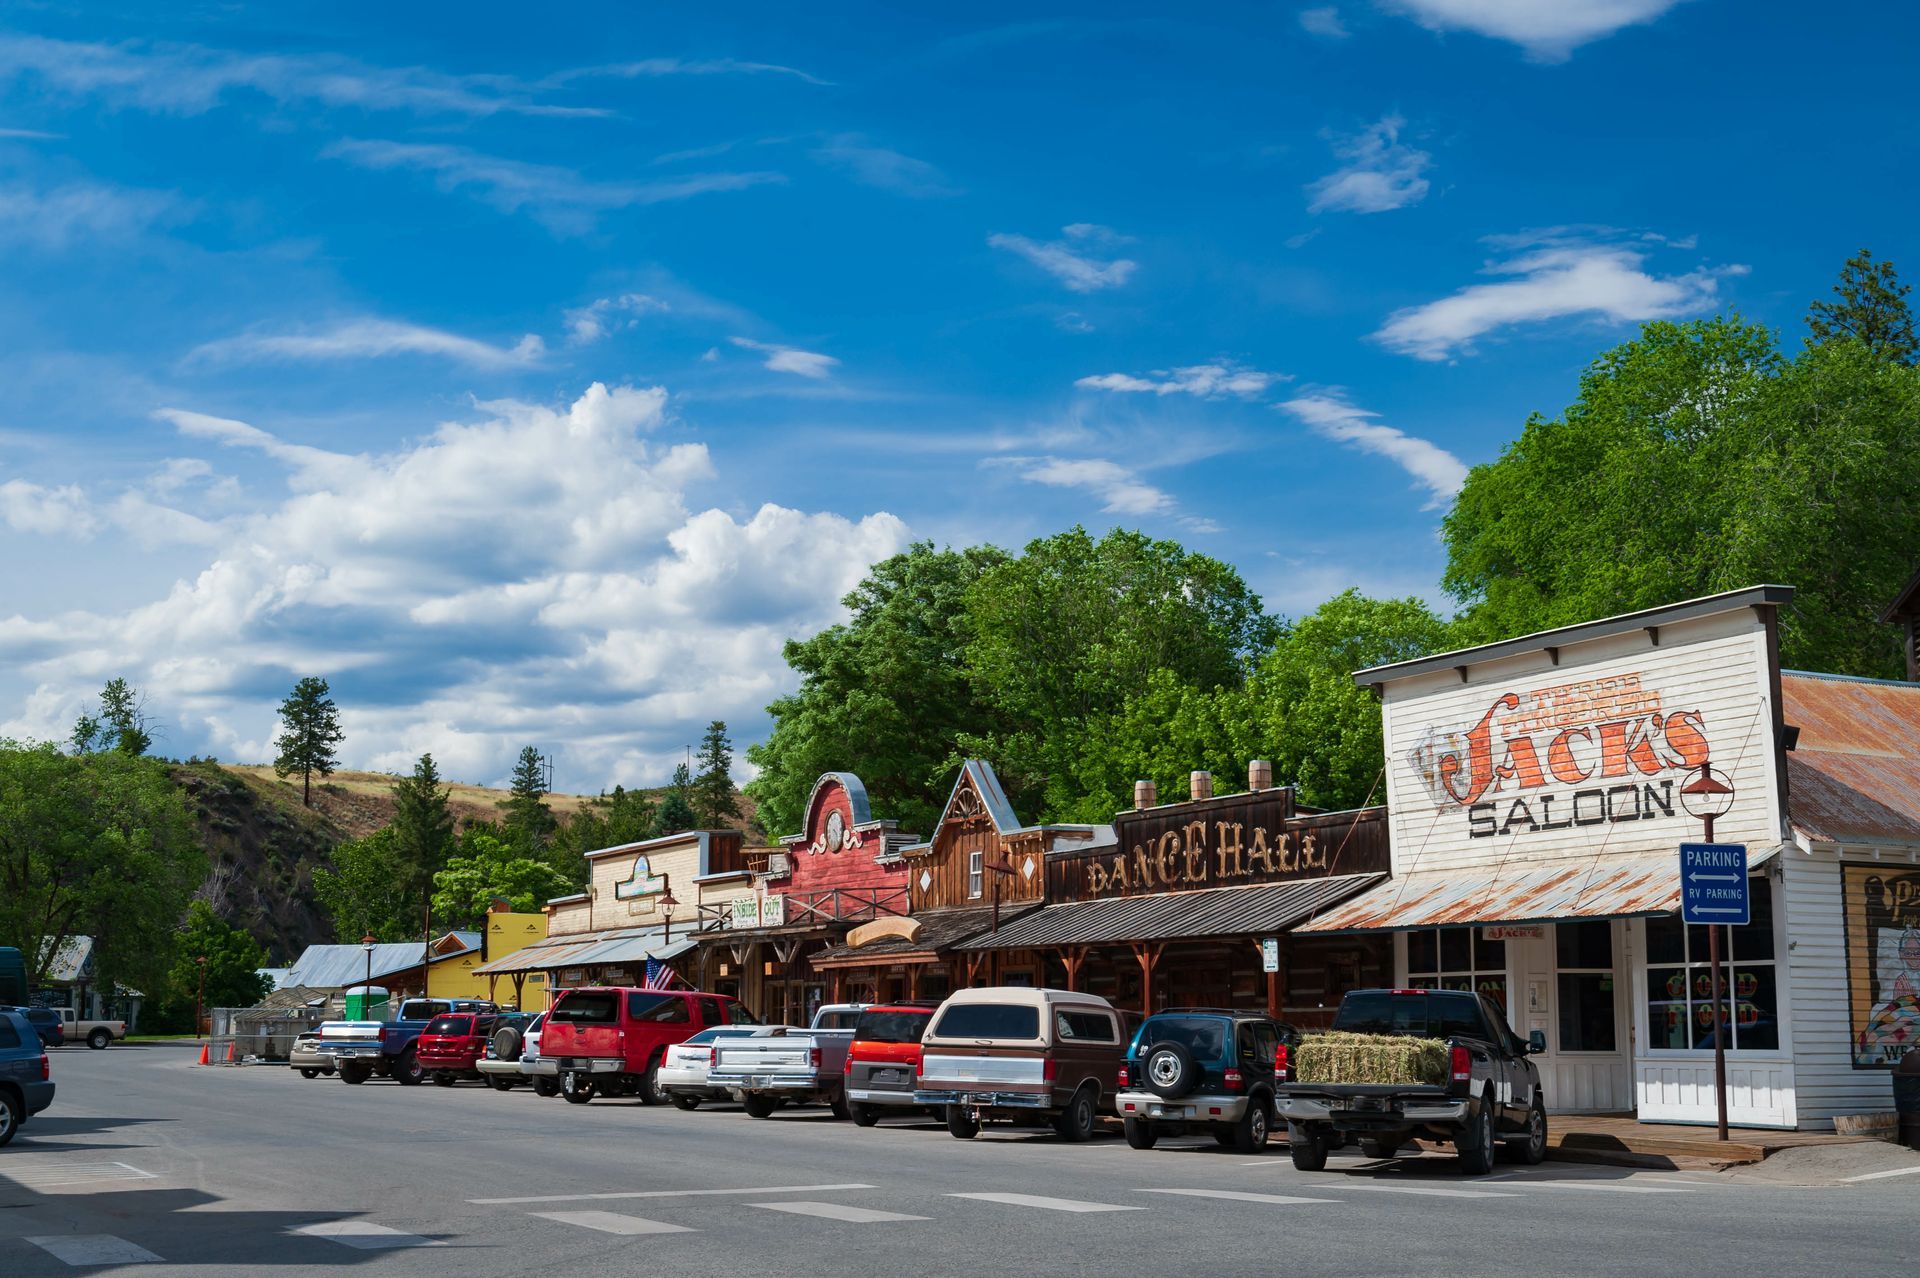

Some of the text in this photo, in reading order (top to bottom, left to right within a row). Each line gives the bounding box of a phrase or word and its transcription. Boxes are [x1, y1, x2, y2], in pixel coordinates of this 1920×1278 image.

[1530, 672, 1642, 709] THREE
[1497, 690, 1662, 736] FINGERED
[1440, 693, 1710, 806] JACK'S
[1468, 779, 1675, 839] SALOON
[1086, 820, 1327, 894] DANCE HALL
[1687, 851, 1741, 867] PARKING
[764, 901, 780, 916] OUT
[1689, 888, 1743, 900] RV PARKING
